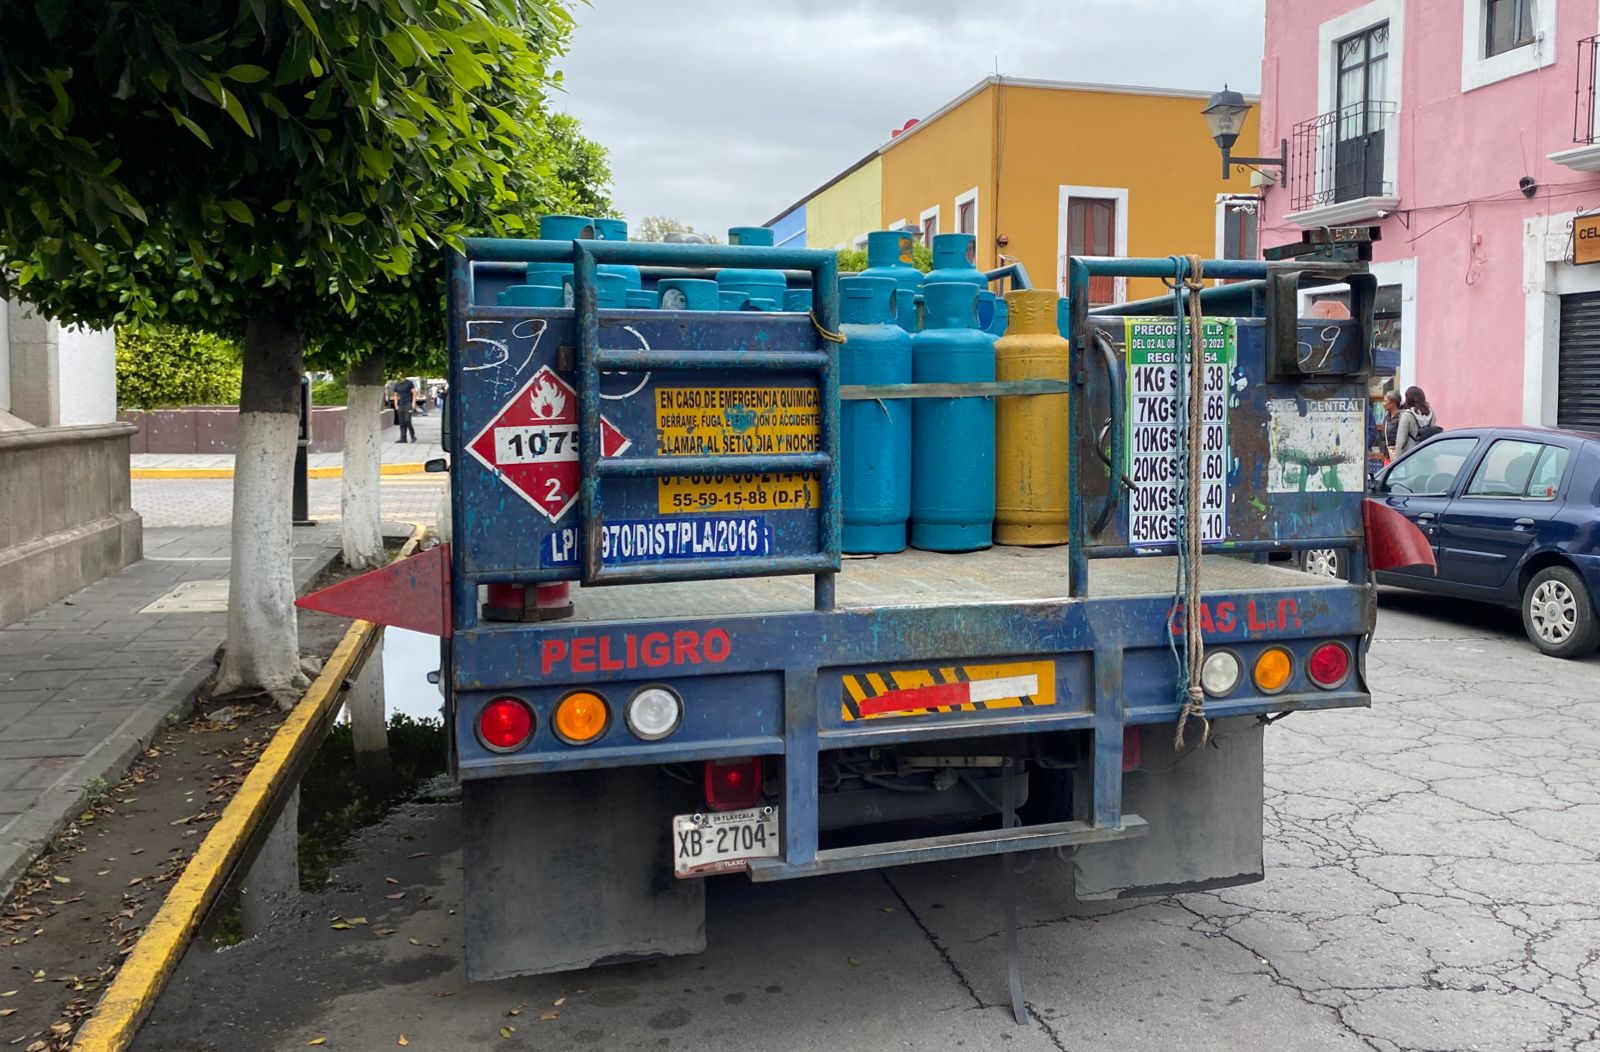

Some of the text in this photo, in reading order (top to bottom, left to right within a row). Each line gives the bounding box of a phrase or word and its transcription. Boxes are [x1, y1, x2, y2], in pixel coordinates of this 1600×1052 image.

[1207, 325, 1224, 335] L.P.
[463, 319, 547, 375] 59
[1132, 339, 1145, 349] DEL
[1157, 339, 1166, 349] AL
[1208, 339, 1225, 348] 2023
[1147, 353, 1191, 363] REGIN
[660, 391, 673, 409] EN
[676, 390, 701, 409] CASO
[704, 390, 716, 408] DE
[719, 390, 778, 409] EMERGENCIA
[772, 415, 777, 426] O
[779, 414, 820, 427] ACCIDENTE
[707, 435, 720, 453] AL
[756, 434, 773, 452] DIA
[776, 434, 783, 452] Y
[785, 433, 820, 452] NOCHE
[544, 478, 562, 502] 2
[673, 491, 767, 507] 55-59-15-88
[1167, 601, 1237, 636] GAS
[541, 627, 732, 675] PELIGRO
[722, 812, 756, 821] TLAXCALA
